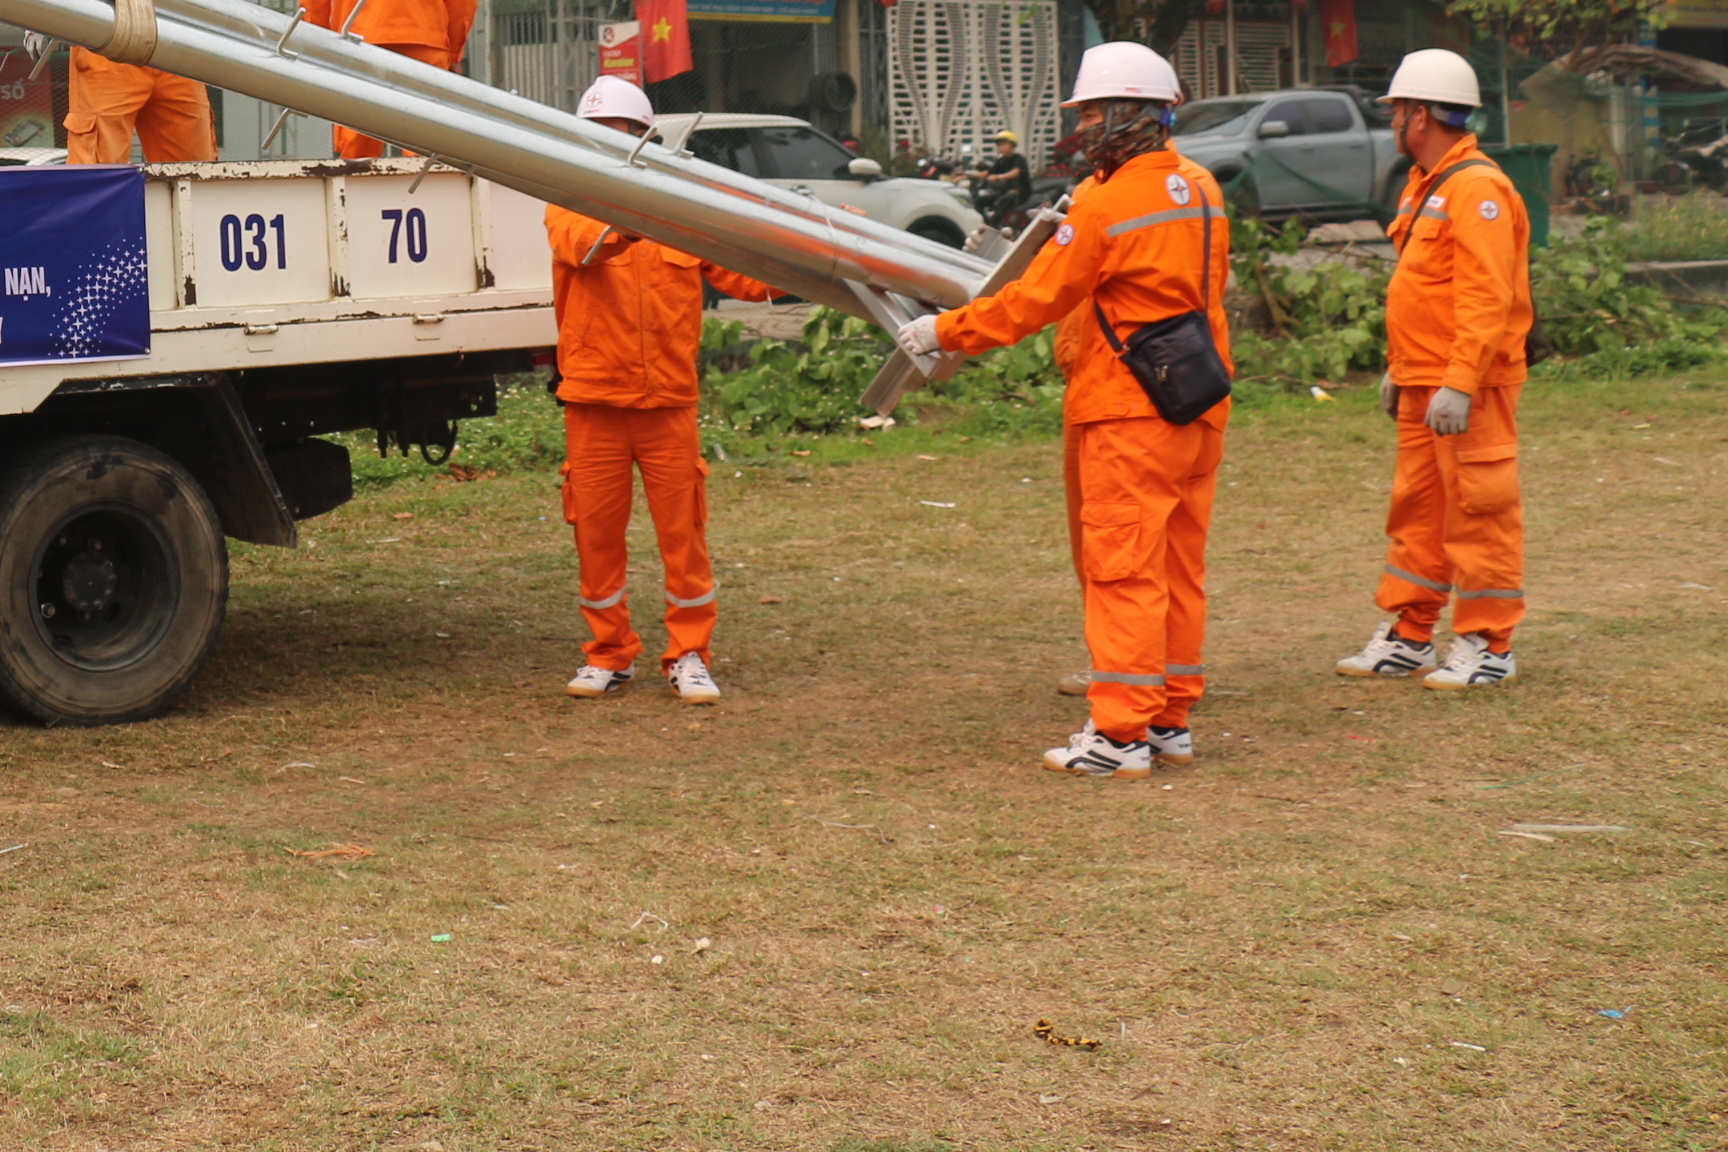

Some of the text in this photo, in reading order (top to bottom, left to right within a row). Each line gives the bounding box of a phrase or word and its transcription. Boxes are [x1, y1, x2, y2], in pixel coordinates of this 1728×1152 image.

[0, 77, 26, 99] SỐ
[220, 213, 286, 271] 031
[382, 207, 428, 263] 70
[5, 266, 51, 301] NẠN,
